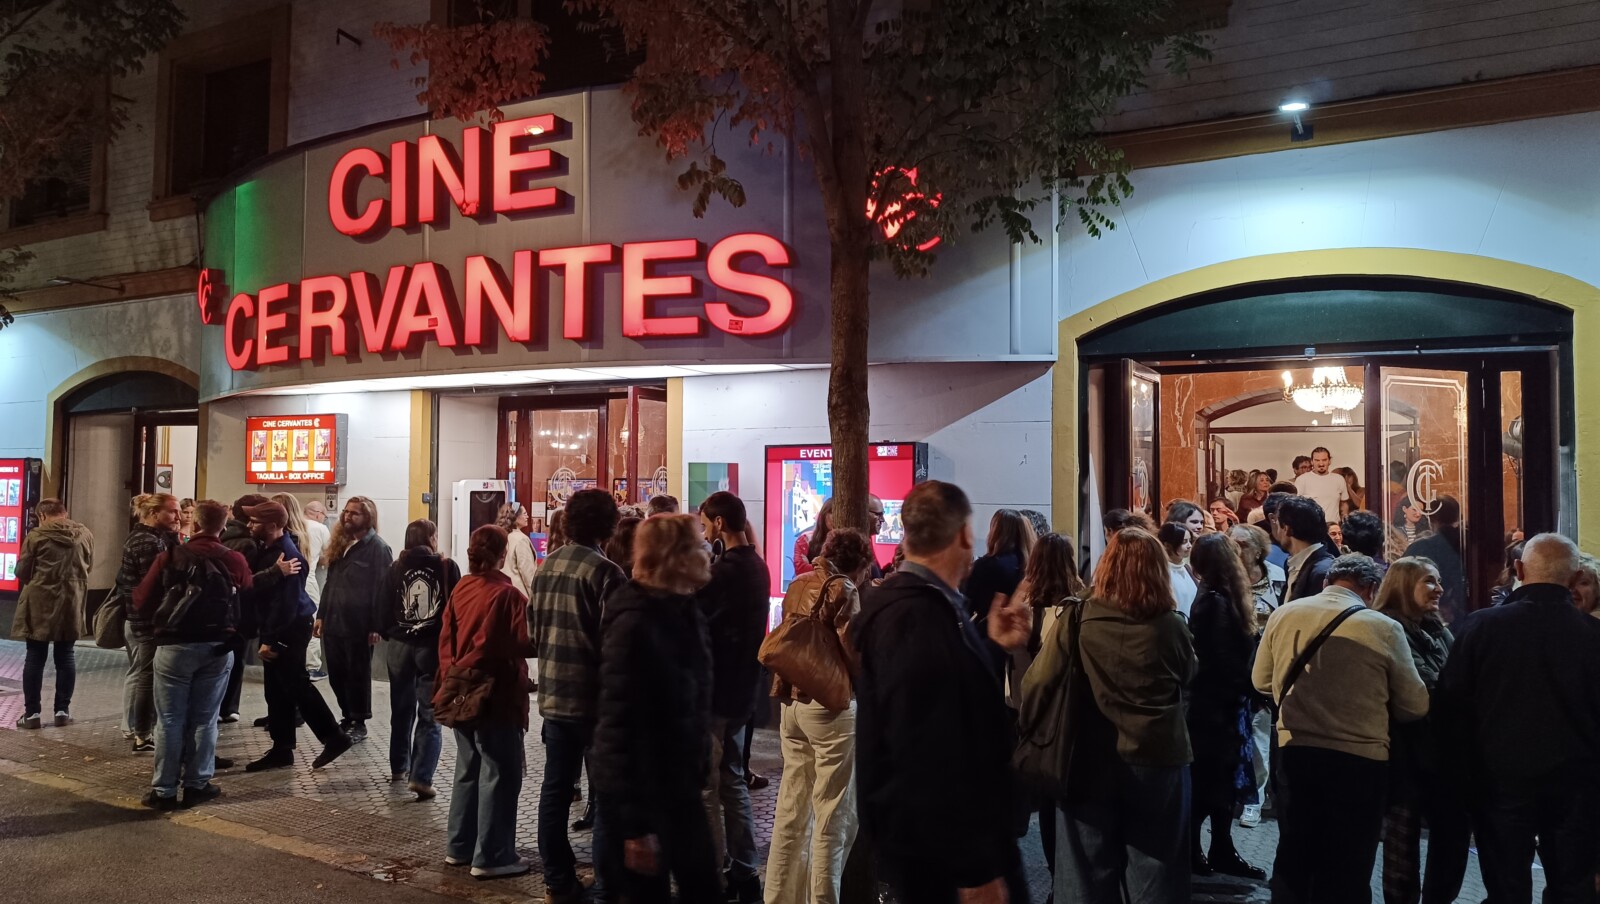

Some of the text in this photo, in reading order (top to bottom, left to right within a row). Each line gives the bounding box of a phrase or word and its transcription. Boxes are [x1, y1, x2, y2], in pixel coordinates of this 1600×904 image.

[328, 113, 558, 236] CINE
[224, 232, 794, 371] CERVANTES
[277, 419, 312, 427] CERVANTES
